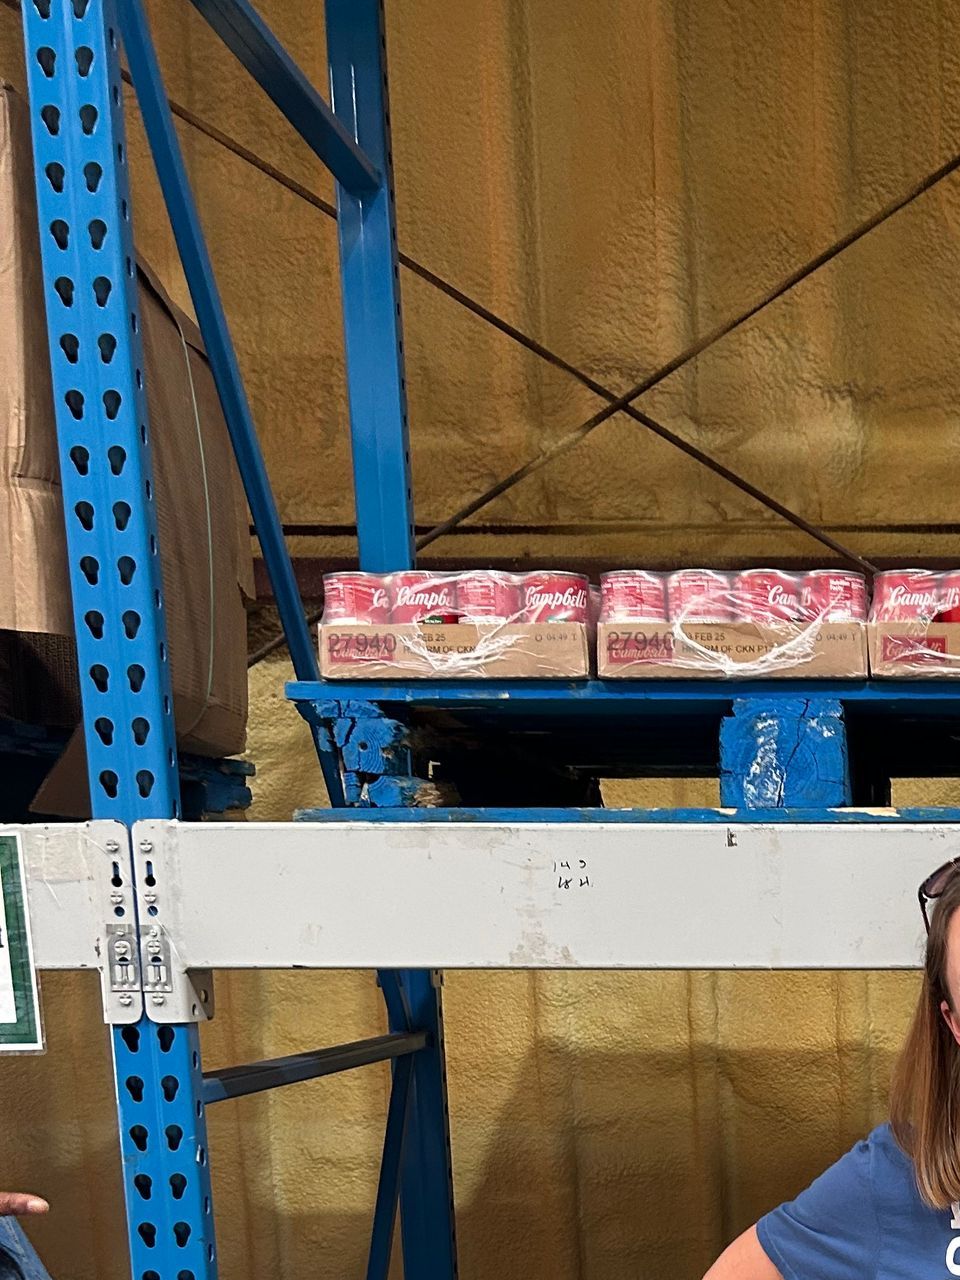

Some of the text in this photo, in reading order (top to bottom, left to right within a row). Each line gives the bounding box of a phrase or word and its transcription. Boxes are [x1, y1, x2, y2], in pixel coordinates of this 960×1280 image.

[328, 632, 398, 654] 27940
[607, 631, 676, 652] 27940
[694, 632, 713, 641] FEB
[714, 632, 726, 641] 25
[720, 645, 733, 653] OF
[735, 645, 755, 653] CKN
